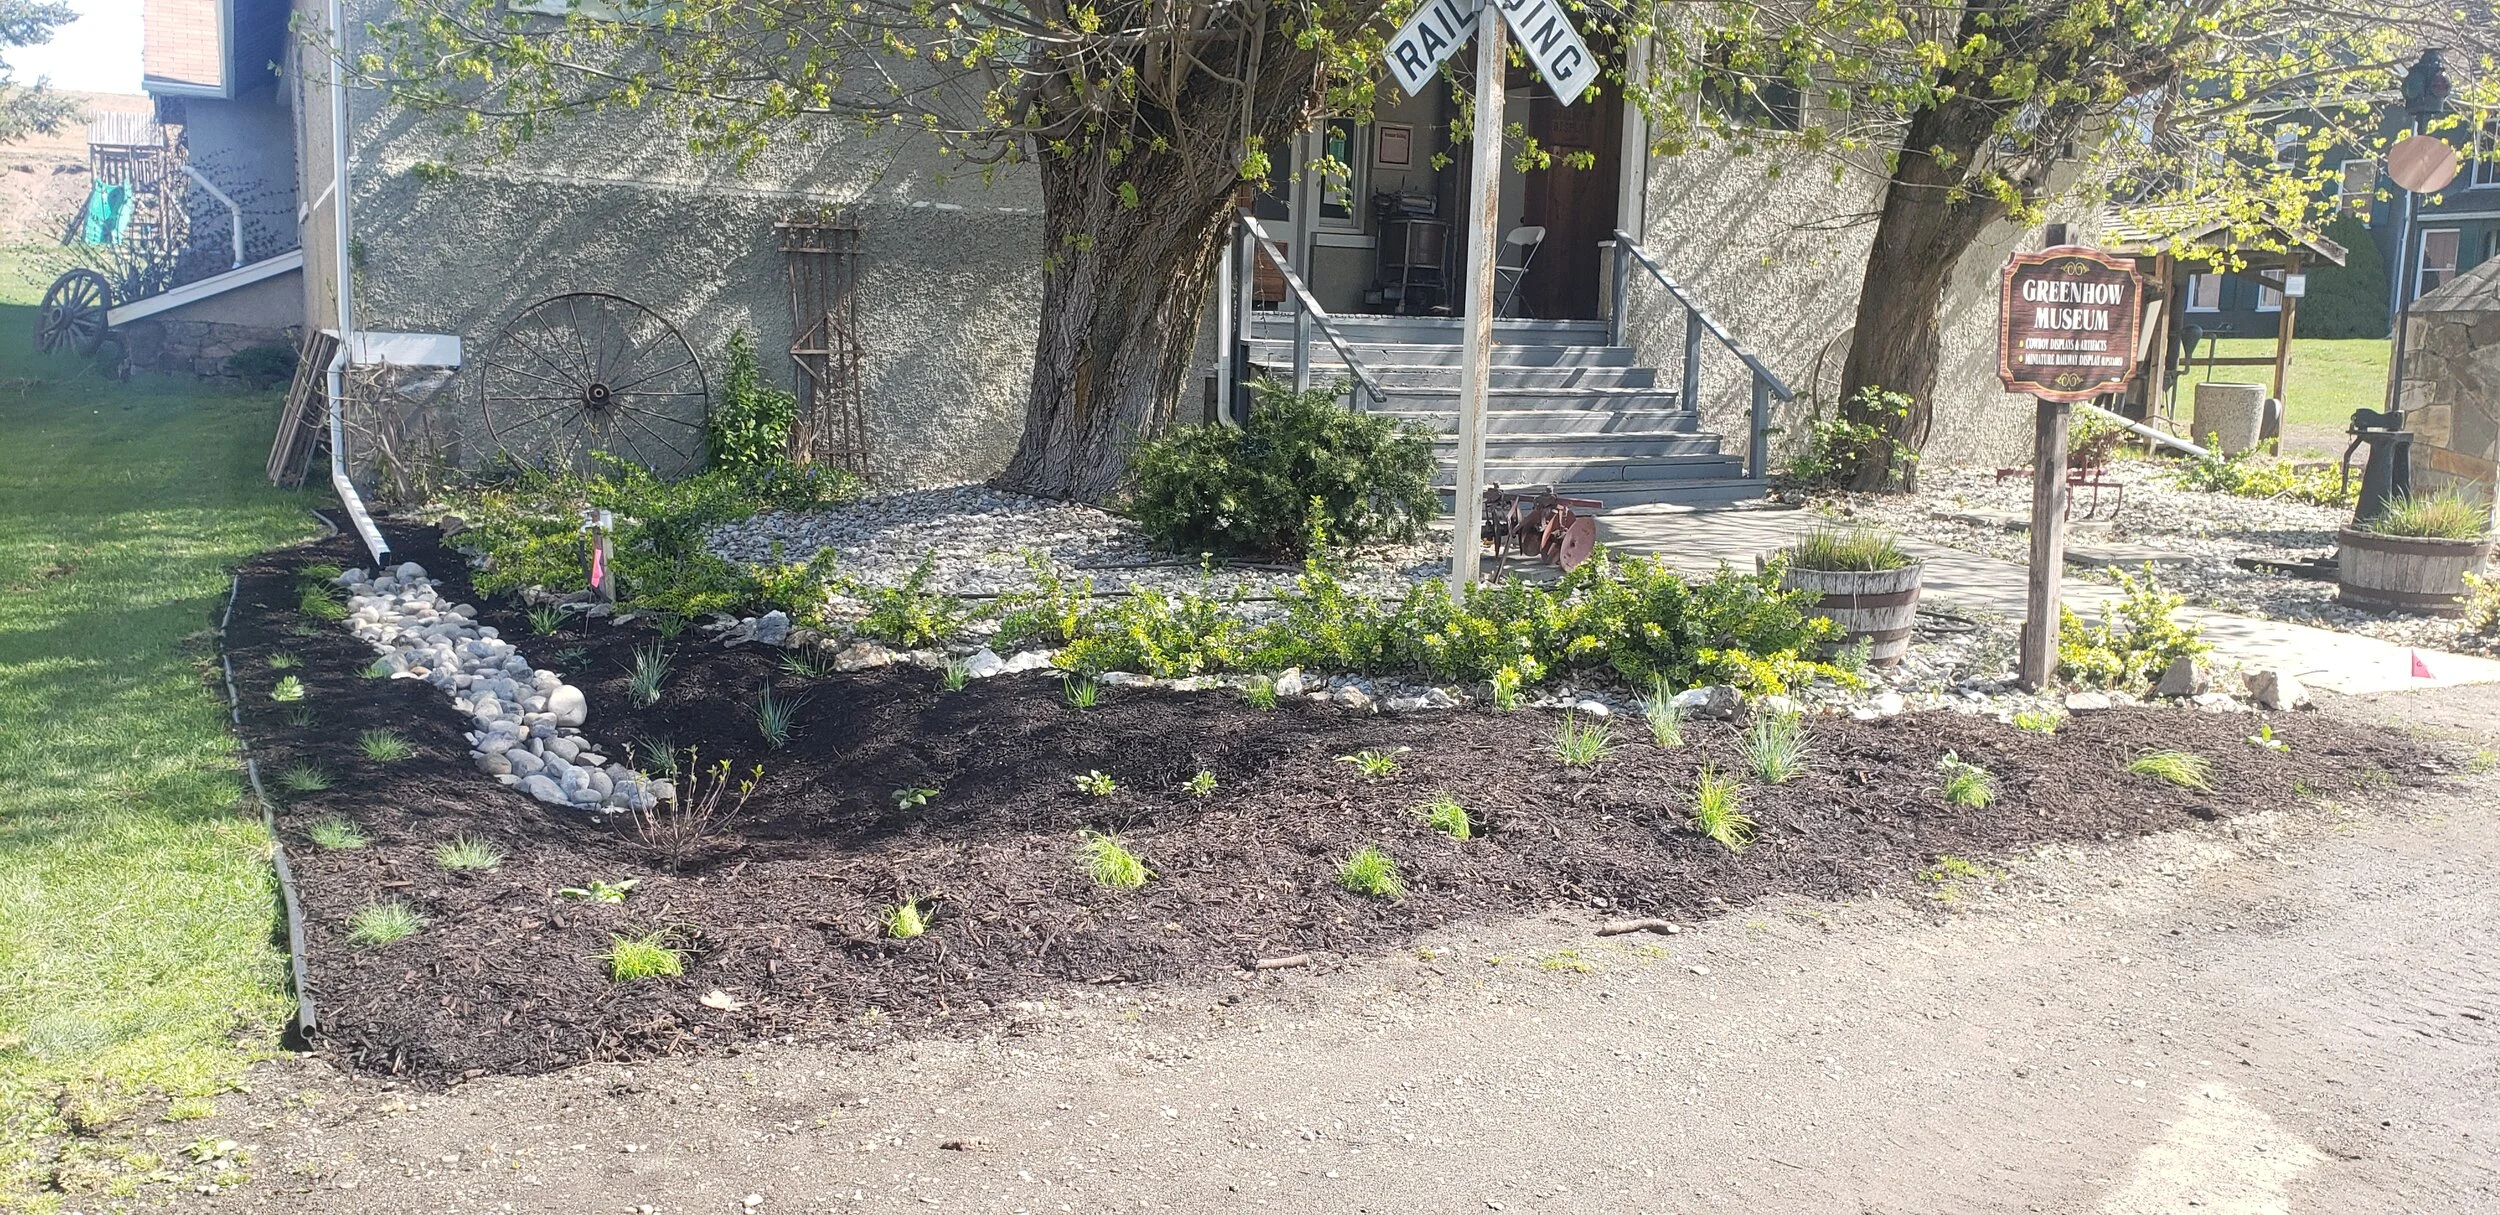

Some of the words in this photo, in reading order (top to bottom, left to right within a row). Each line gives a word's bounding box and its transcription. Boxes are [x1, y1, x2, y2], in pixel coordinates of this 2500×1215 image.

[2022, 279, 2125, 305] GREENHOW
[2034, 307, 2109, 331] MUSEUM
[2025, 338, 2049, 350] COWBOY
[2050, 338, 2074, 351] DISPLAYS
[2080, 340, 2107, 352] ARTIFACTS
[2024, 353, 2055, 366] MINIATURE
[2055, 354, 2079, 366] RAILWAY
[2079, 354, 2101, 367] DISPLAY
